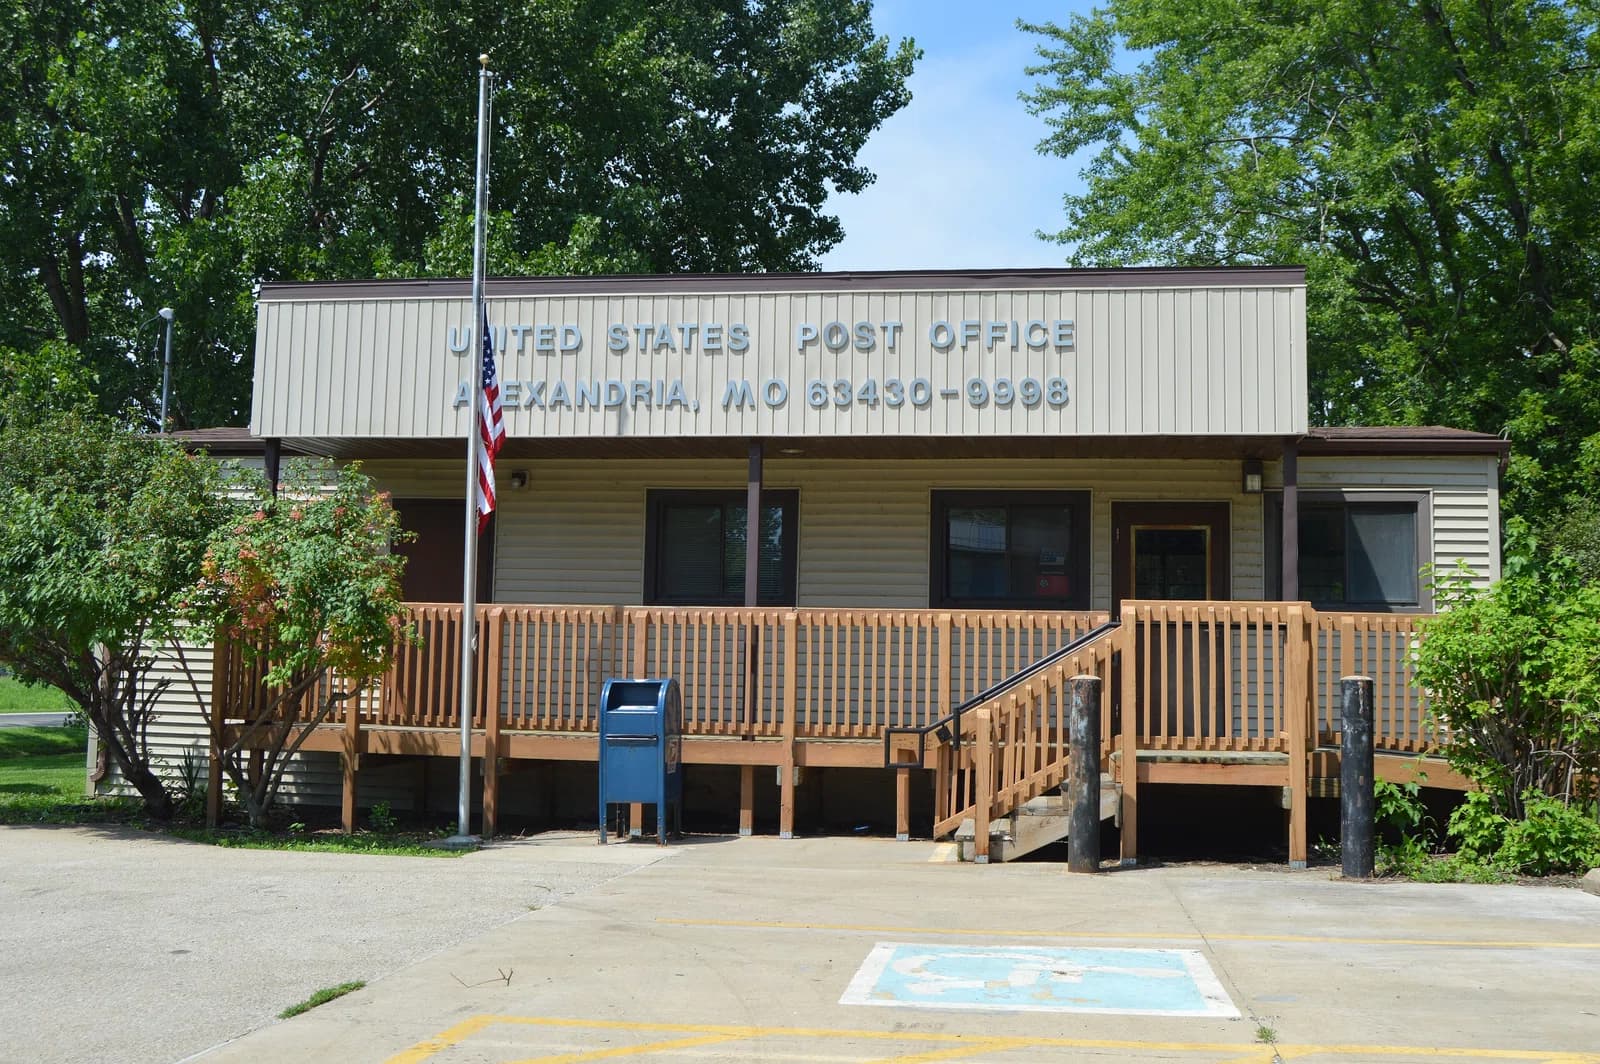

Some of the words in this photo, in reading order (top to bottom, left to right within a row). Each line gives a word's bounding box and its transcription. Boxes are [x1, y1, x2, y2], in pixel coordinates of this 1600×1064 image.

[448, 324, 583, 353] UITED
[608, 323, 750, 352] STATES
[797, 319, 904, 351] POST
[928, 319, 1075, 350] OFFICE
[453, 378, 701, 411] AEXANDRIA,
[721, 377, 788, 407] MO
[807, 376, 1070, 407] 63430-9998
